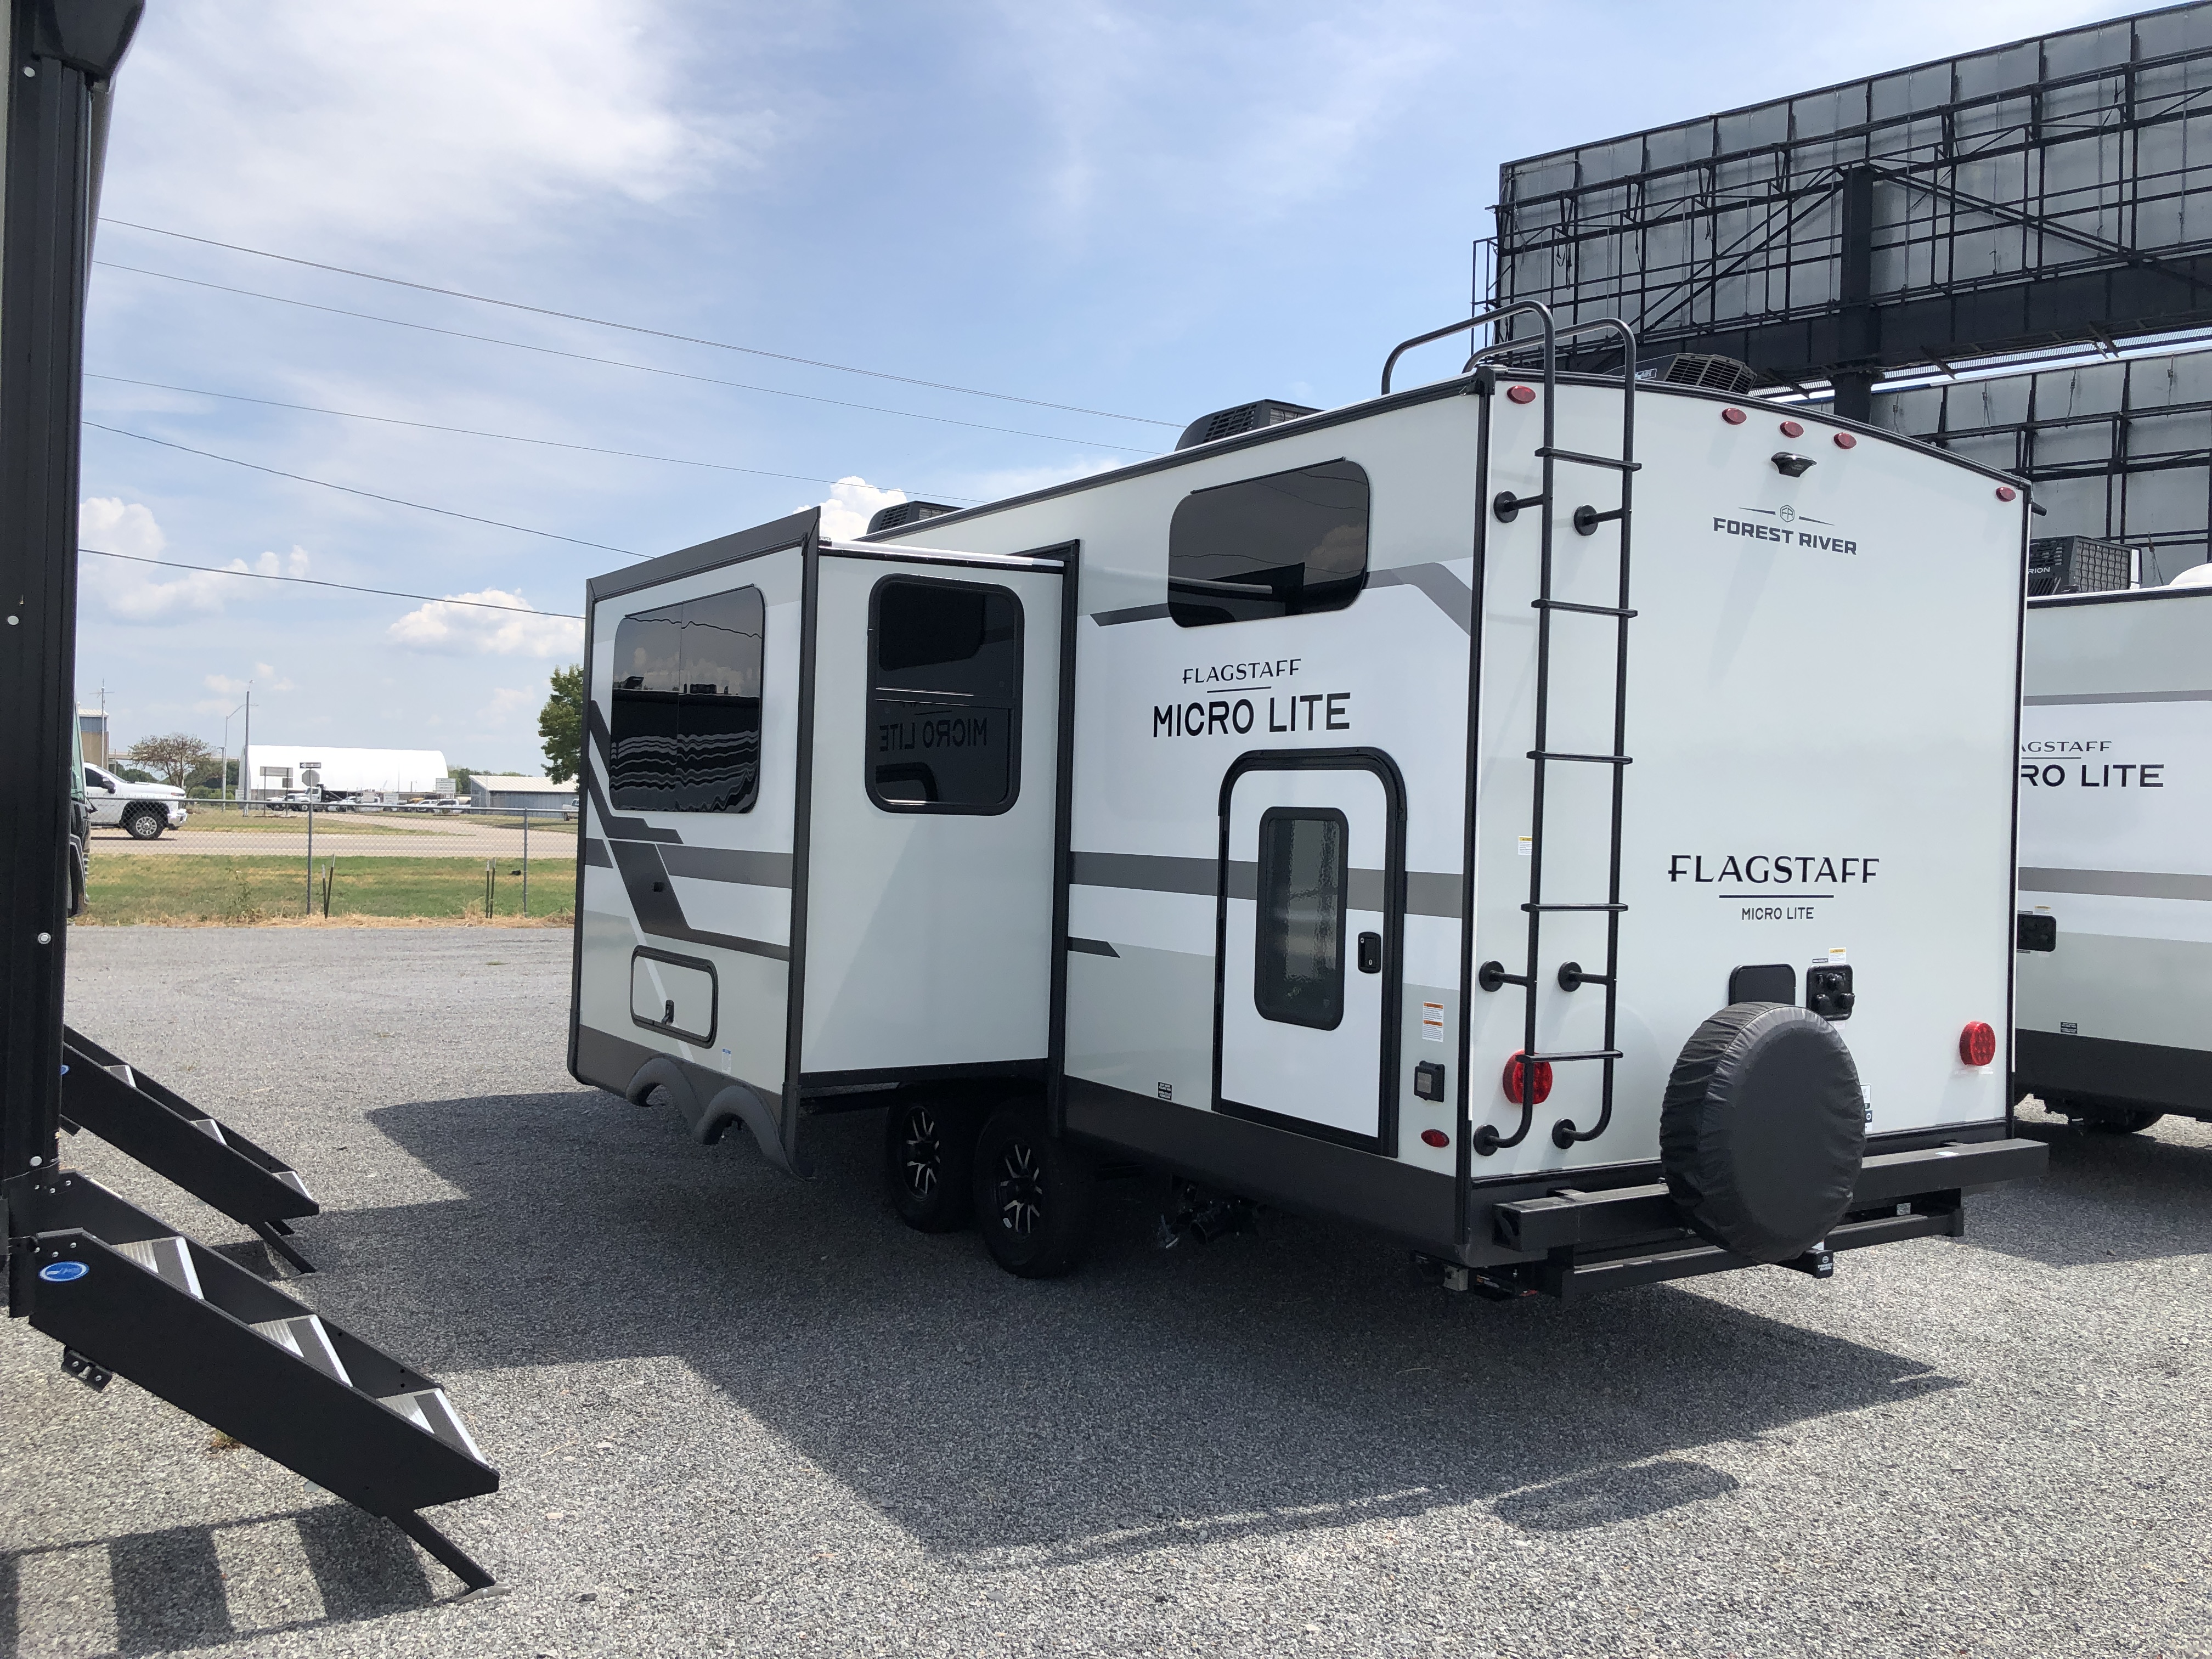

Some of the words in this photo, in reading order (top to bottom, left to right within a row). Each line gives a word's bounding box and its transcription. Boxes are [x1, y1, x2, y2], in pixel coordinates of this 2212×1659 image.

[1713, 517, 1794, 544] FOREST
[1798, 532, 1857, 555] RIVER
[1182, 658, 1301, 684] FLAGSTAFF
[1153, 698, 1254, 738] MICRO
[1269, 692, 1351, 732] LITE
[2081, 764, 2164, 787] LITE
[1668, 855, 1880, 883] FLAGSTAFF
[1742, 907, 1782, 920] MICRO
[1787, 907, 1814, 919] LITE
